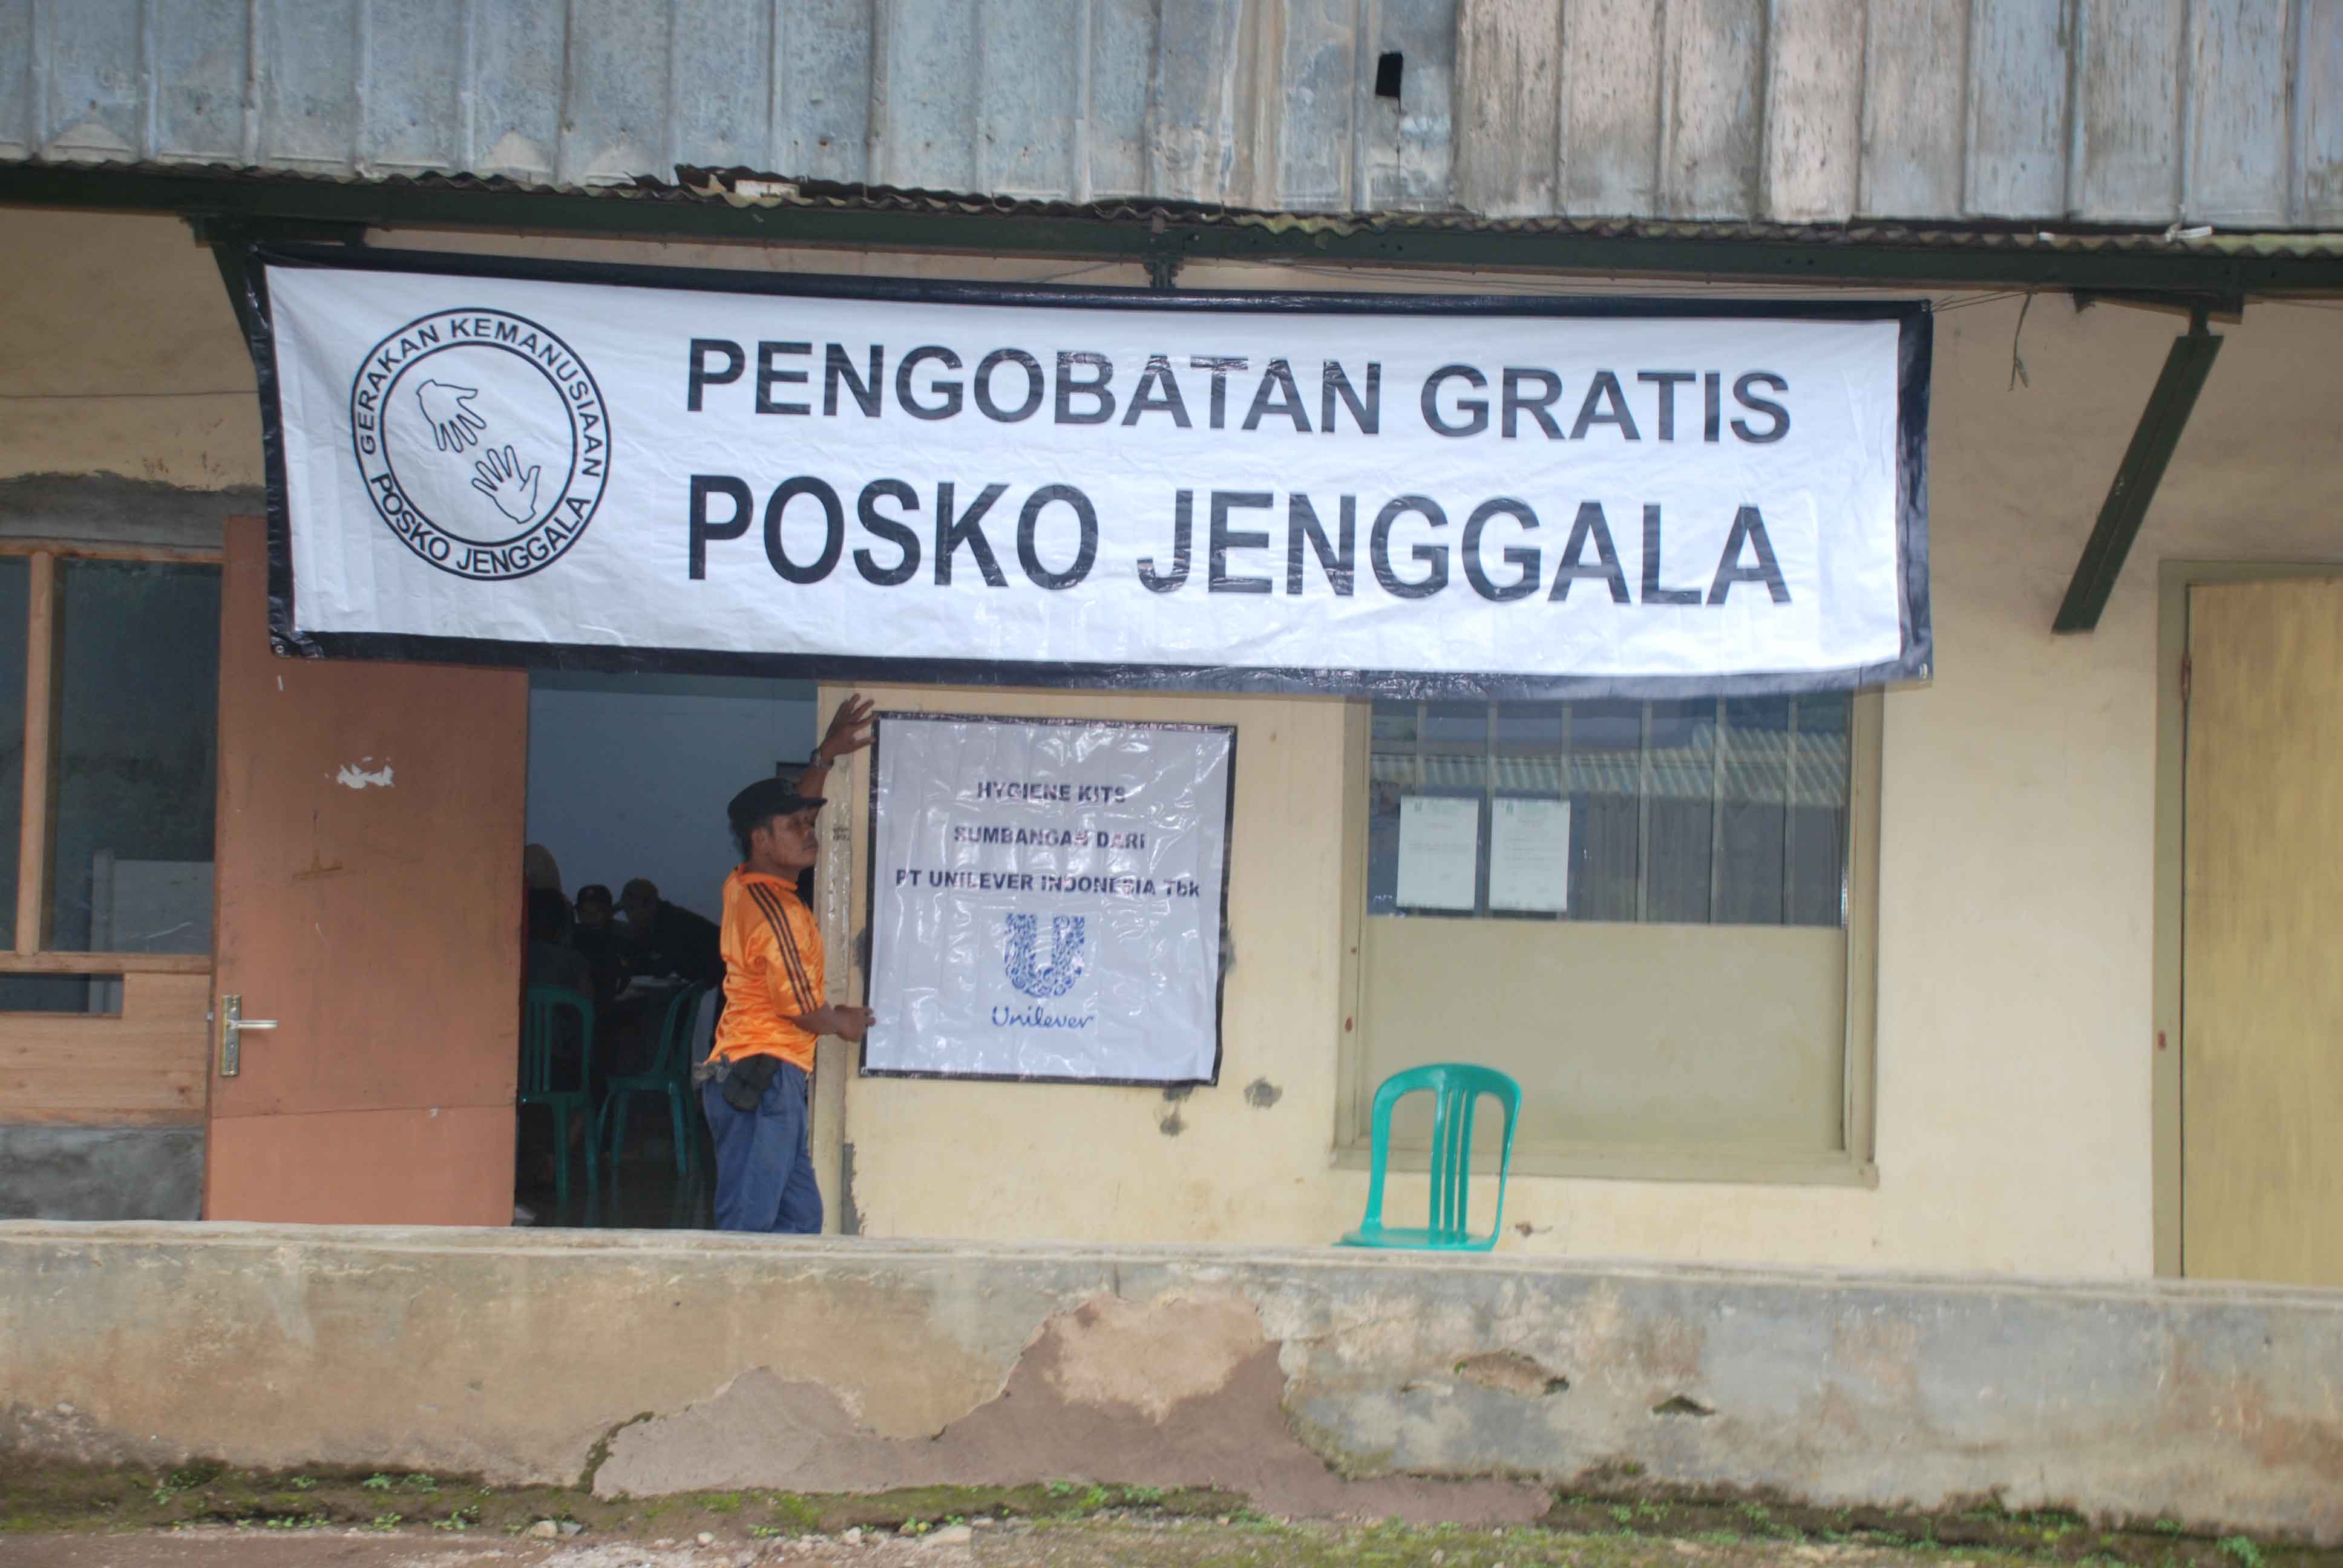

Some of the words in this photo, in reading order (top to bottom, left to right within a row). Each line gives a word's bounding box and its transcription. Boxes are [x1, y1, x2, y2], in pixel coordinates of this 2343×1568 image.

[359, 325, 441, 455] GERAKAN
[451, 318, 603, 477] KEMANUSIAAN
[687, 338, 1382, 435] PENGOBATAN
[1420, 364, 1791, 444] GRATIS
[371, 473, 450, 561] POSKO
[456, 497, 591, 573] JENGGALA
[689, 474, 1099, 590] POSKO
[1136, 489, 1792, 605] JENGGALA
[977, 782, 1070, 801] HYGIENE
[1078, 784, 1126, 803] KITS
[1096, 831, 1145, 849] DARI
[896, 869, 922, 887] PT
[929, 870, 1033, 891] UNILEVER
[1041, 875, 1155, 895] INDONESIA
[1163, 879, 1200, 898] Tbk
[992, 1005, 1094, 1028] Unilever
